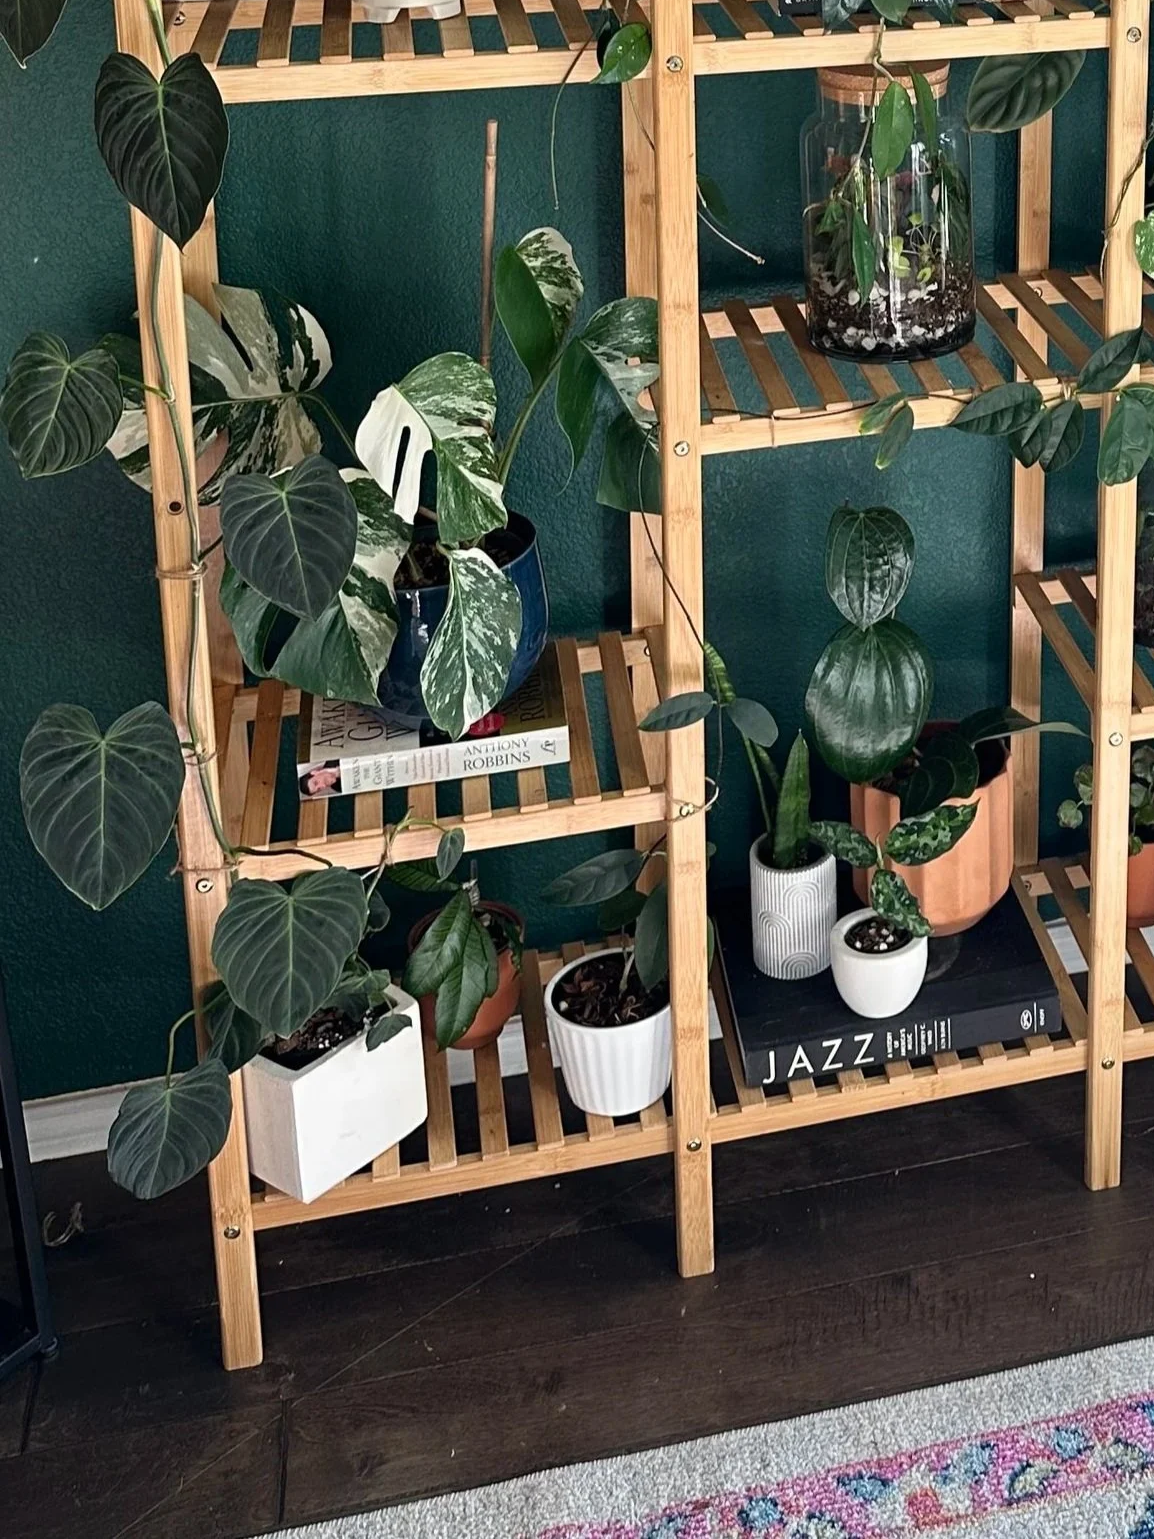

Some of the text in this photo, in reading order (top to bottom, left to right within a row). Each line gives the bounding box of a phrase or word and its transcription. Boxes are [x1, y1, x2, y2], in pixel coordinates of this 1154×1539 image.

[314, 698, 346, 749] AWAK
[463, 751, 531, 771] ROBBINS
[464, 737, 530, 756] ANTHONY
[762, 1032, 875, 1084] JAZZ
